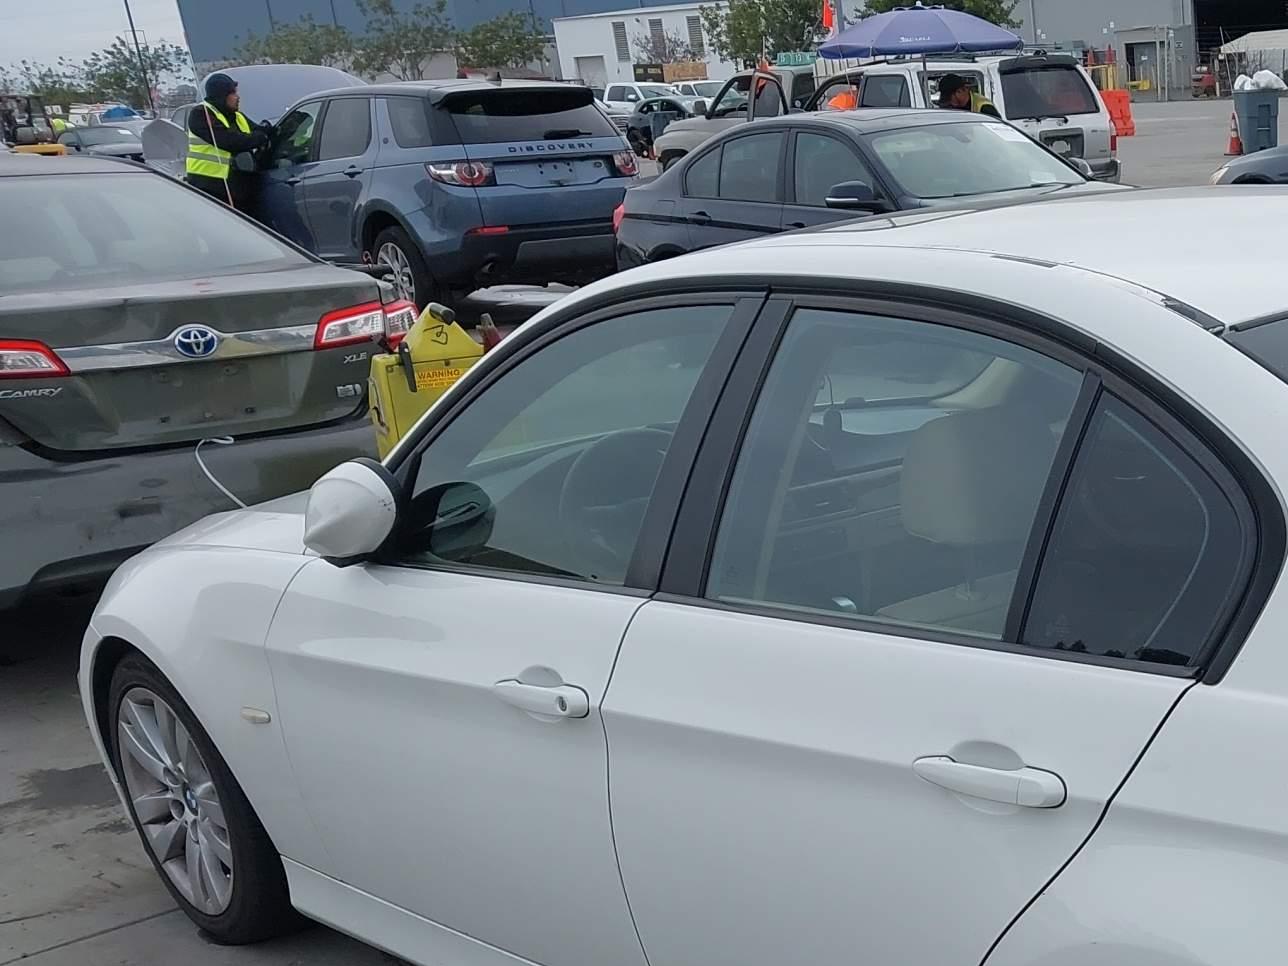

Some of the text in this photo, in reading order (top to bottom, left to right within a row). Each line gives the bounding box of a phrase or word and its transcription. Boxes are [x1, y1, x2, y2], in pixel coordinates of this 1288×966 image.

[508, 142, 593, 153] DISCOVERY
[344, 352, 367, 364] XLE
[417, 369, 460, 380] WARNING
[0, 387, 63, 398] CAMRY
